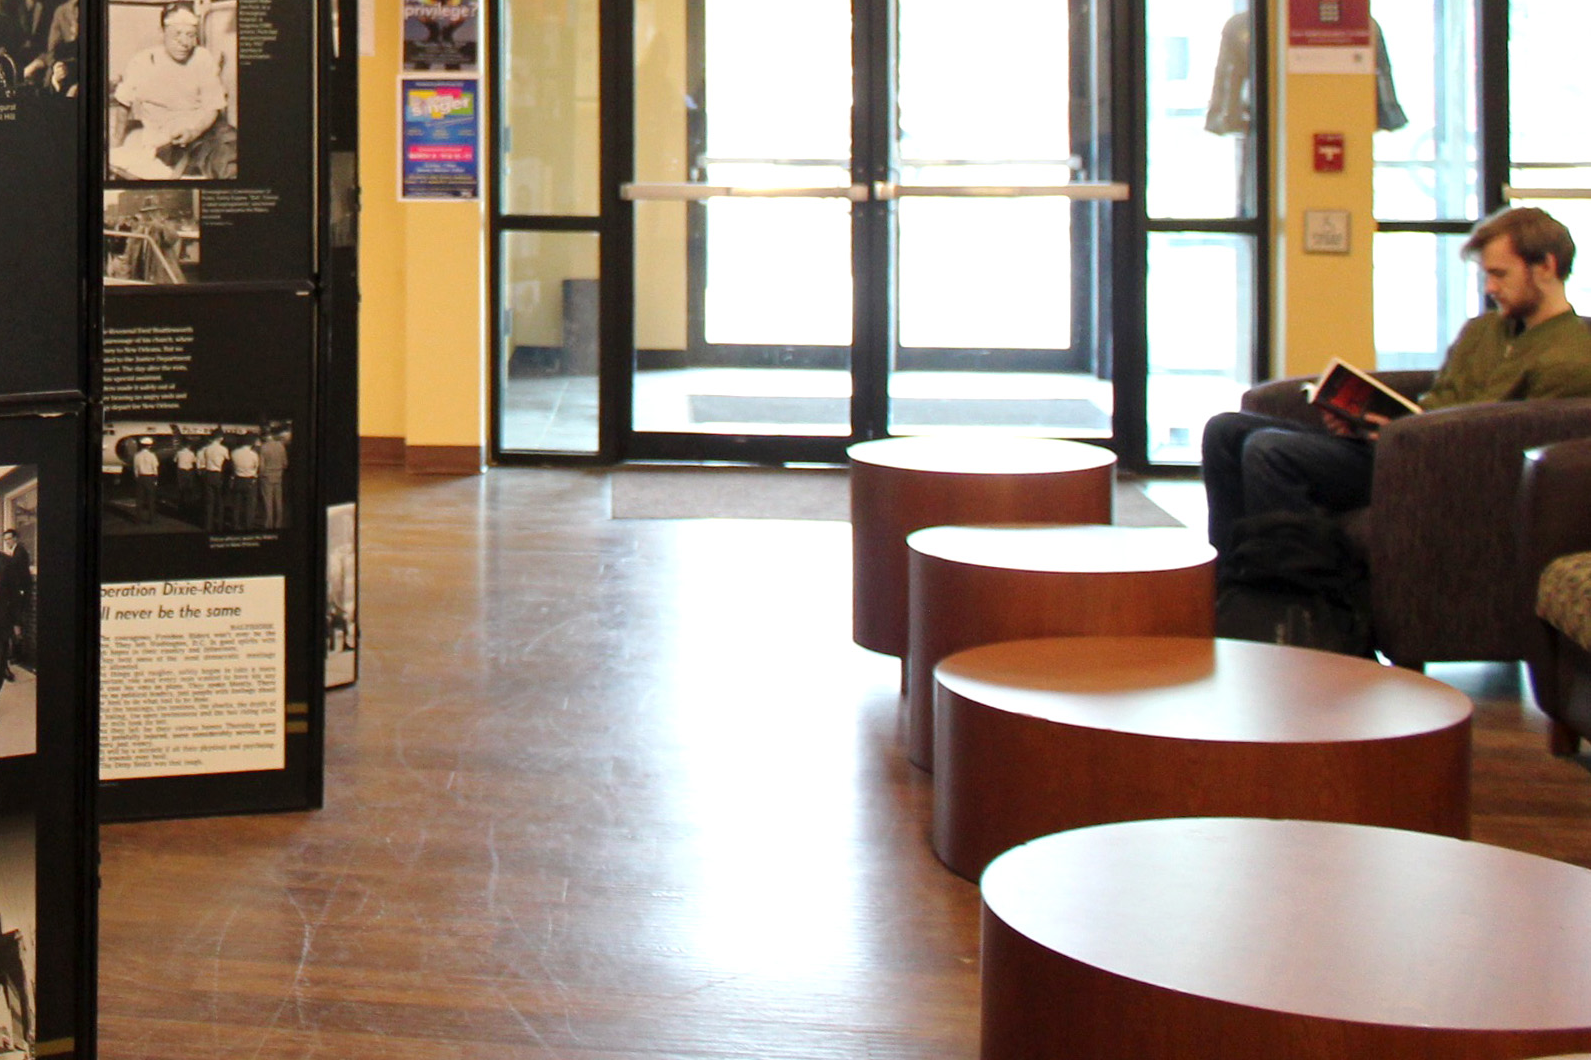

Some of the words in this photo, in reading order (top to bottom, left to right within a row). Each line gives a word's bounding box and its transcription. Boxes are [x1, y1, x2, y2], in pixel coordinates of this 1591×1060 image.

[163, 581, 244, 596] Dixie-Riders
[115, 609, 152, 620] never
[158, 605, 174, 619] be
[179, 605, 201, 618] the
[207, 607, 241, 617] same
